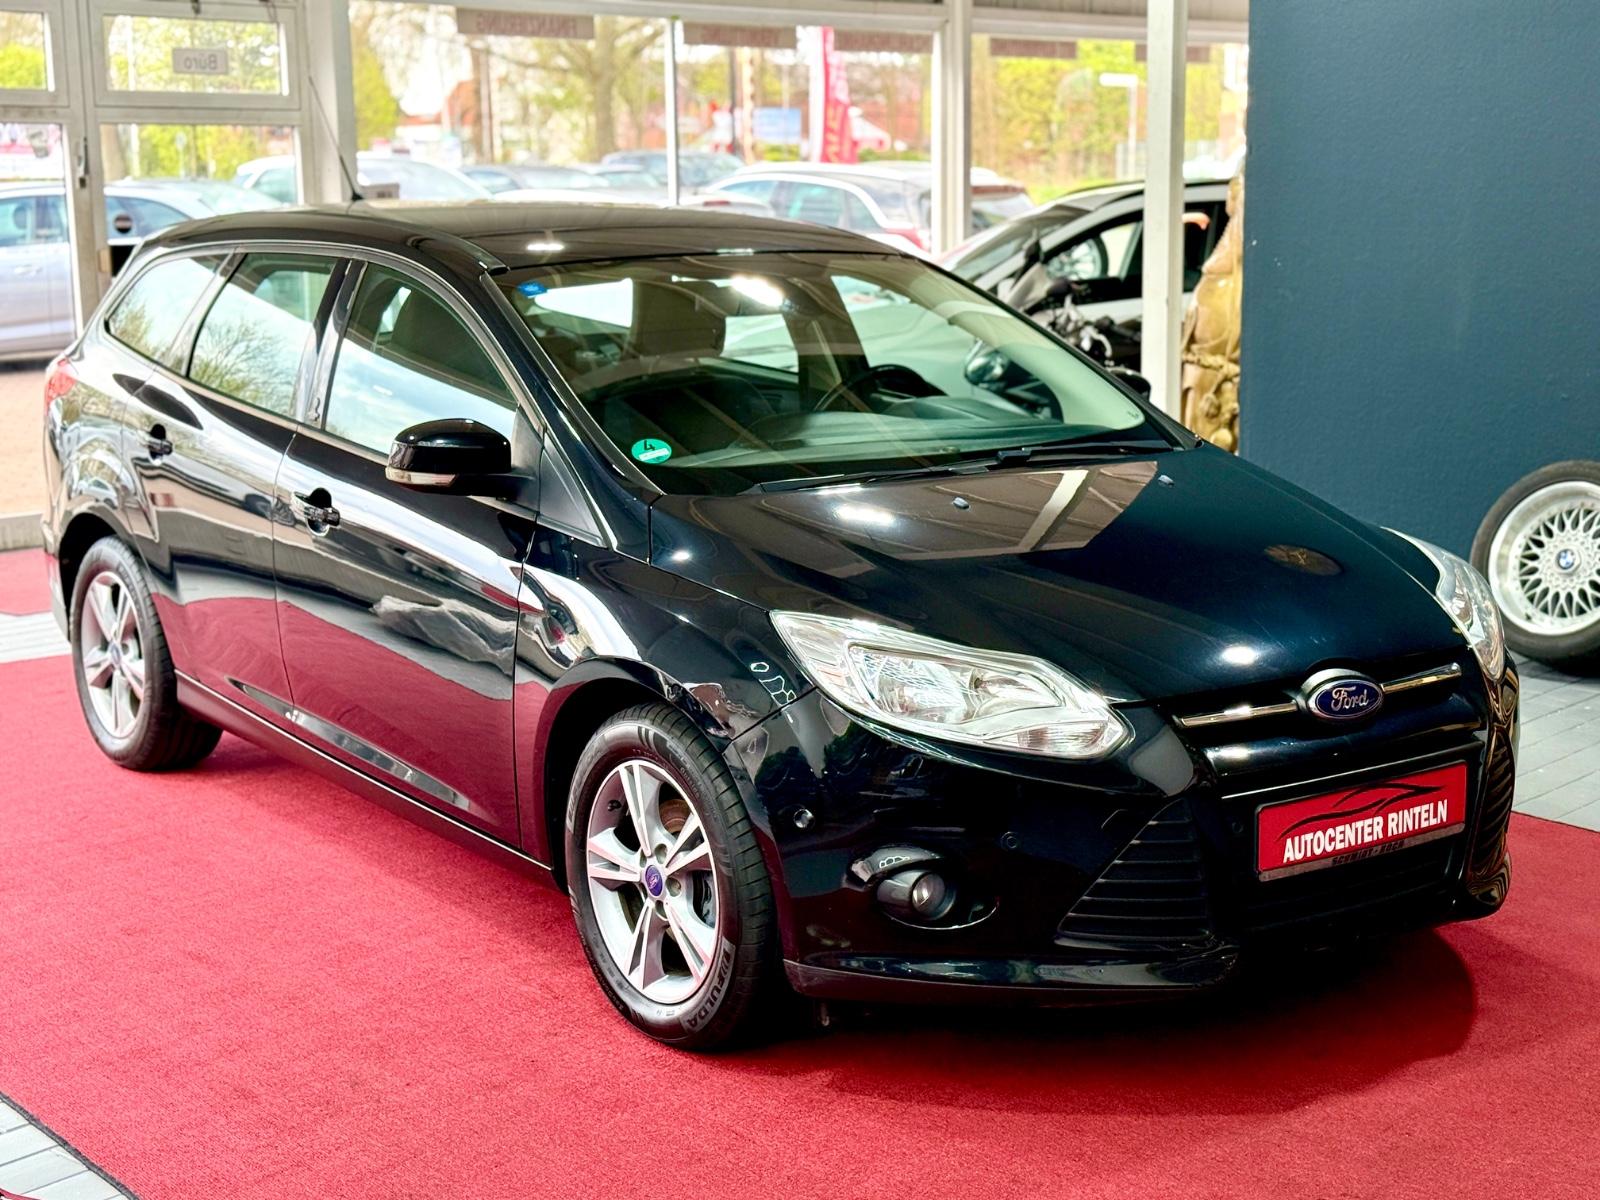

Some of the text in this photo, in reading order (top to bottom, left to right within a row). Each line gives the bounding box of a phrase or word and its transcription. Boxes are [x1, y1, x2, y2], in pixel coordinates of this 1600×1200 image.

[644, 440, 656, 451] 4
[1331, 686, 1369, 711] Ford
[1283, 800, 1447, 863] AUTOCENTER RINTELN
[687, 970, 726, 1028] FULDA
